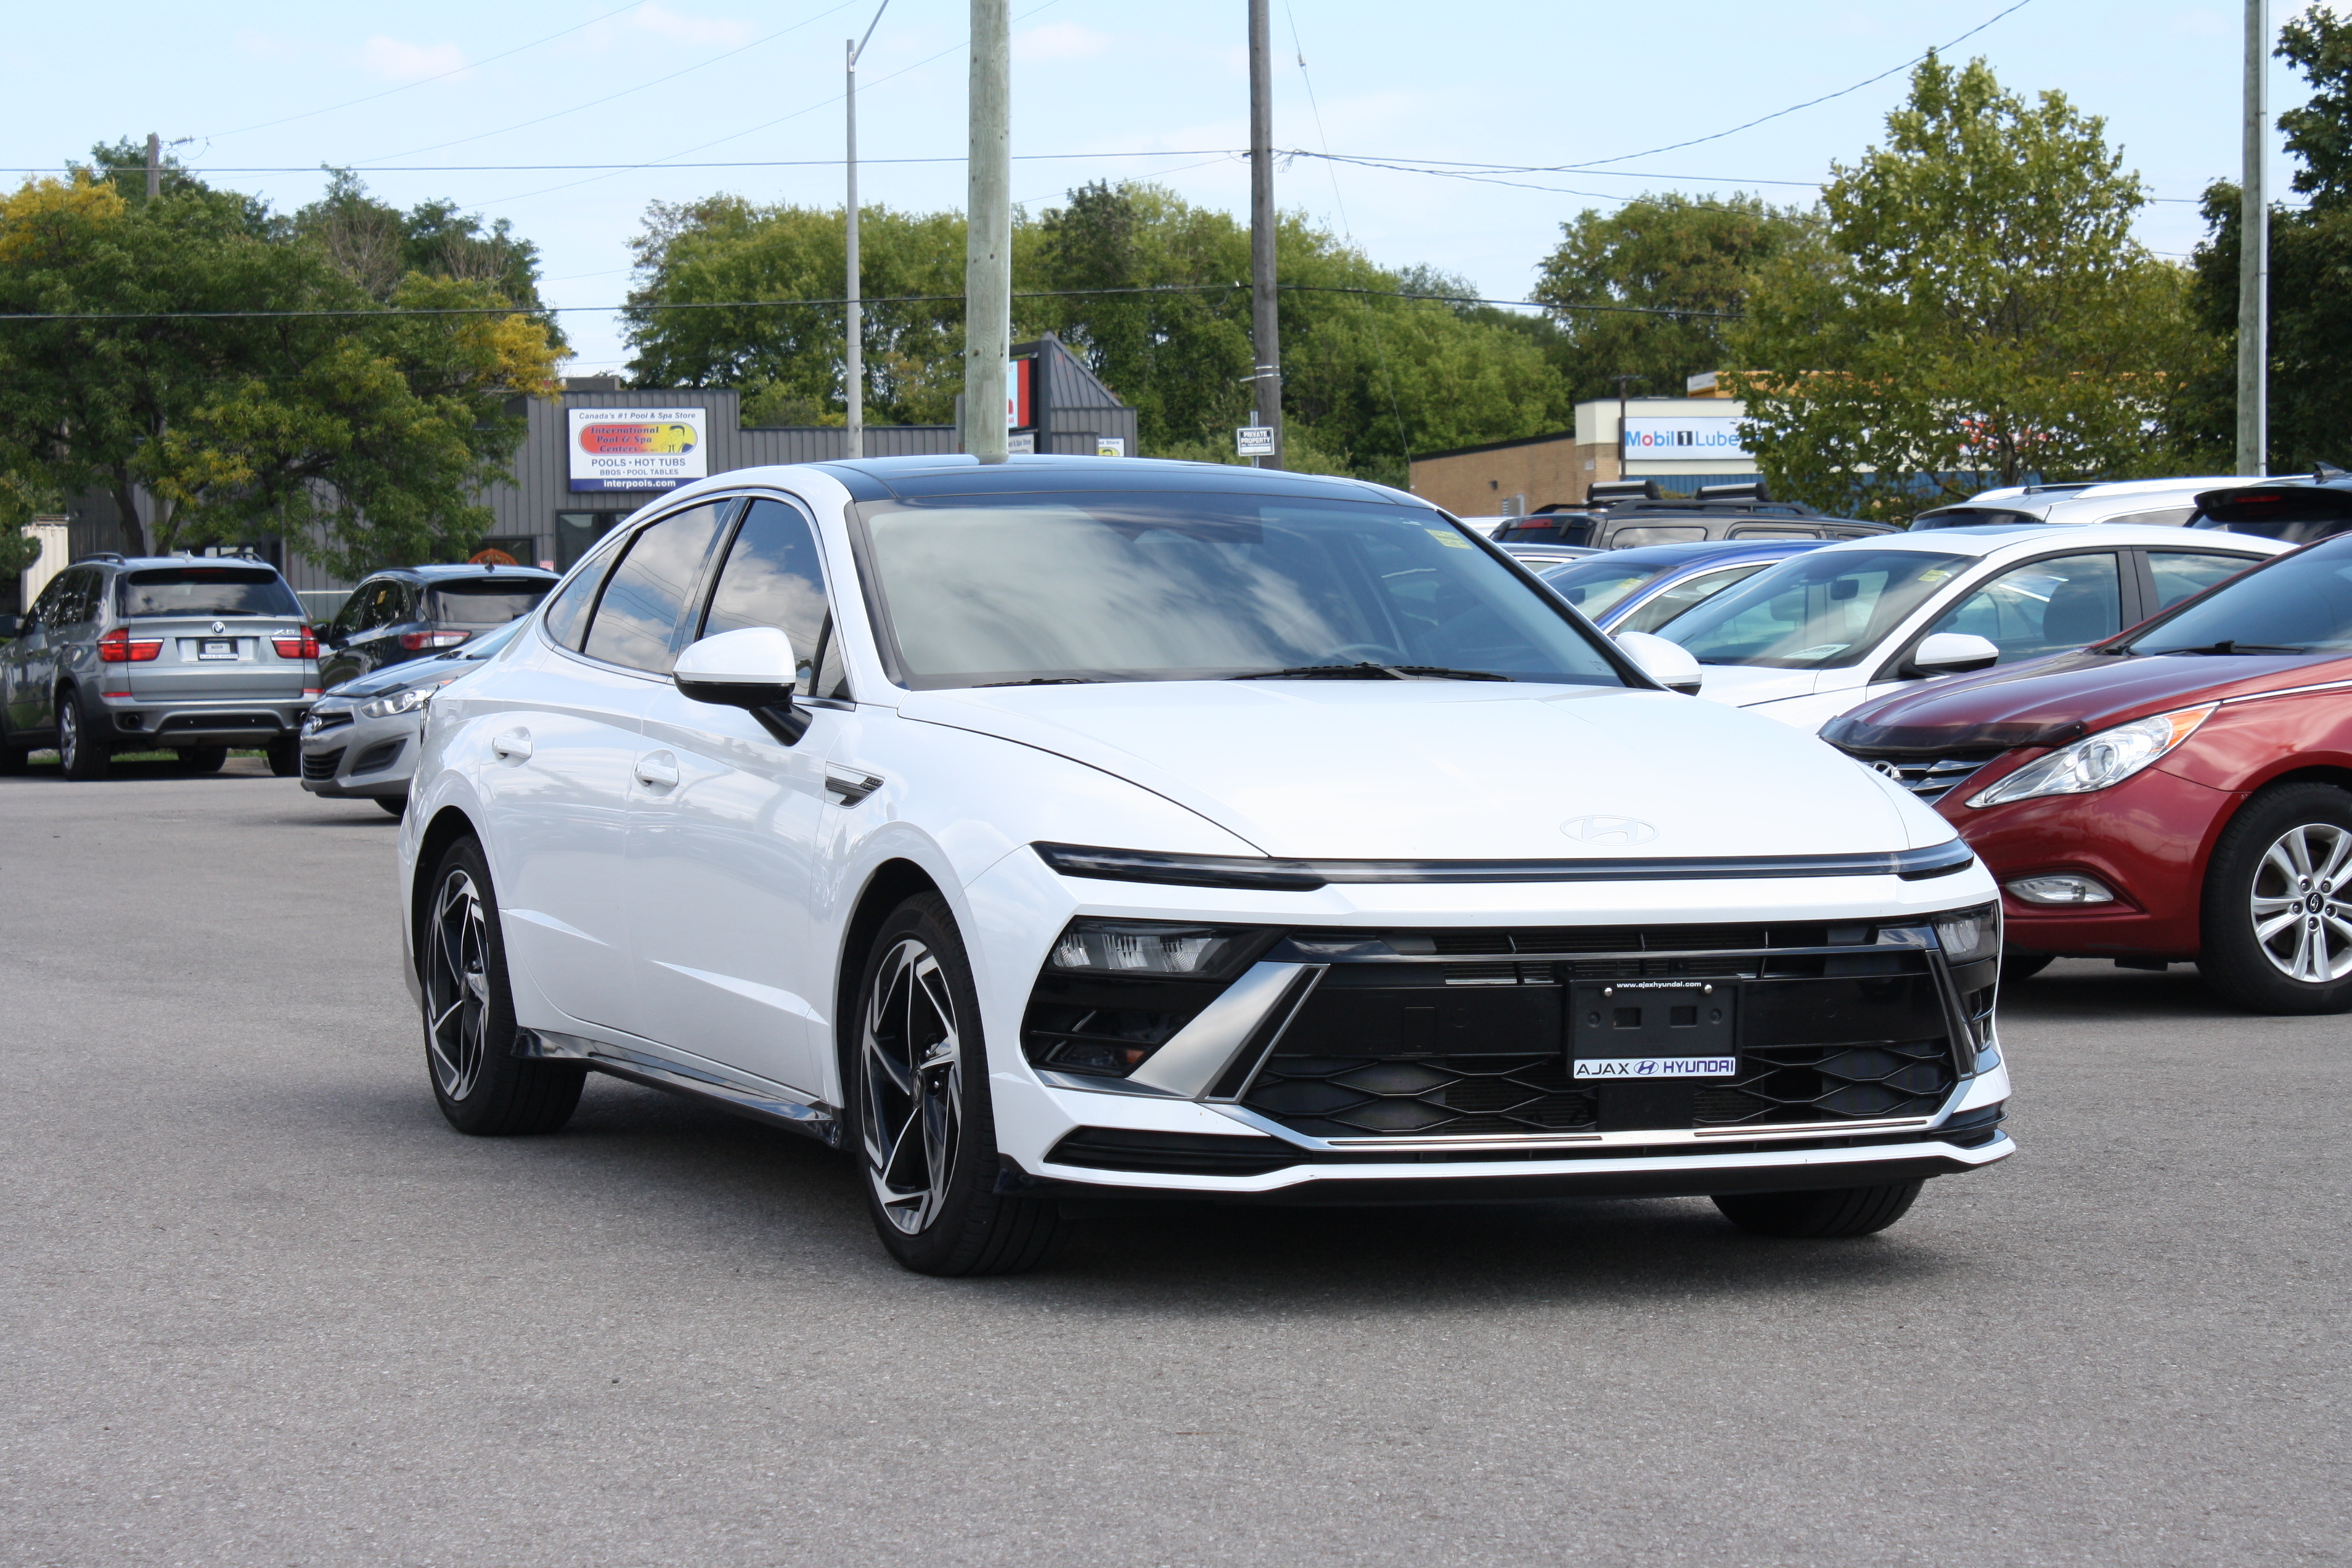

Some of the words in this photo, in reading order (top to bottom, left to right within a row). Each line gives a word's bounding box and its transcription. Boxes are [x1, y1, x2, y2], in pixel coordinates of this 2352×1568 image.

[634, 436, 653, 445] Spa
[1625, 430, 1674, 446] Mobil
[591, 458, 626, 467] POOLS
[634, 458, 656, 467] HOT
[658, 458, 686, 467] TUBS
[603, 480, 676, 489] Interpools.com
[1576, 1062, 1630, 1076] AJAX
[1663, 1059, 1734, 1074] HYUNDAI
